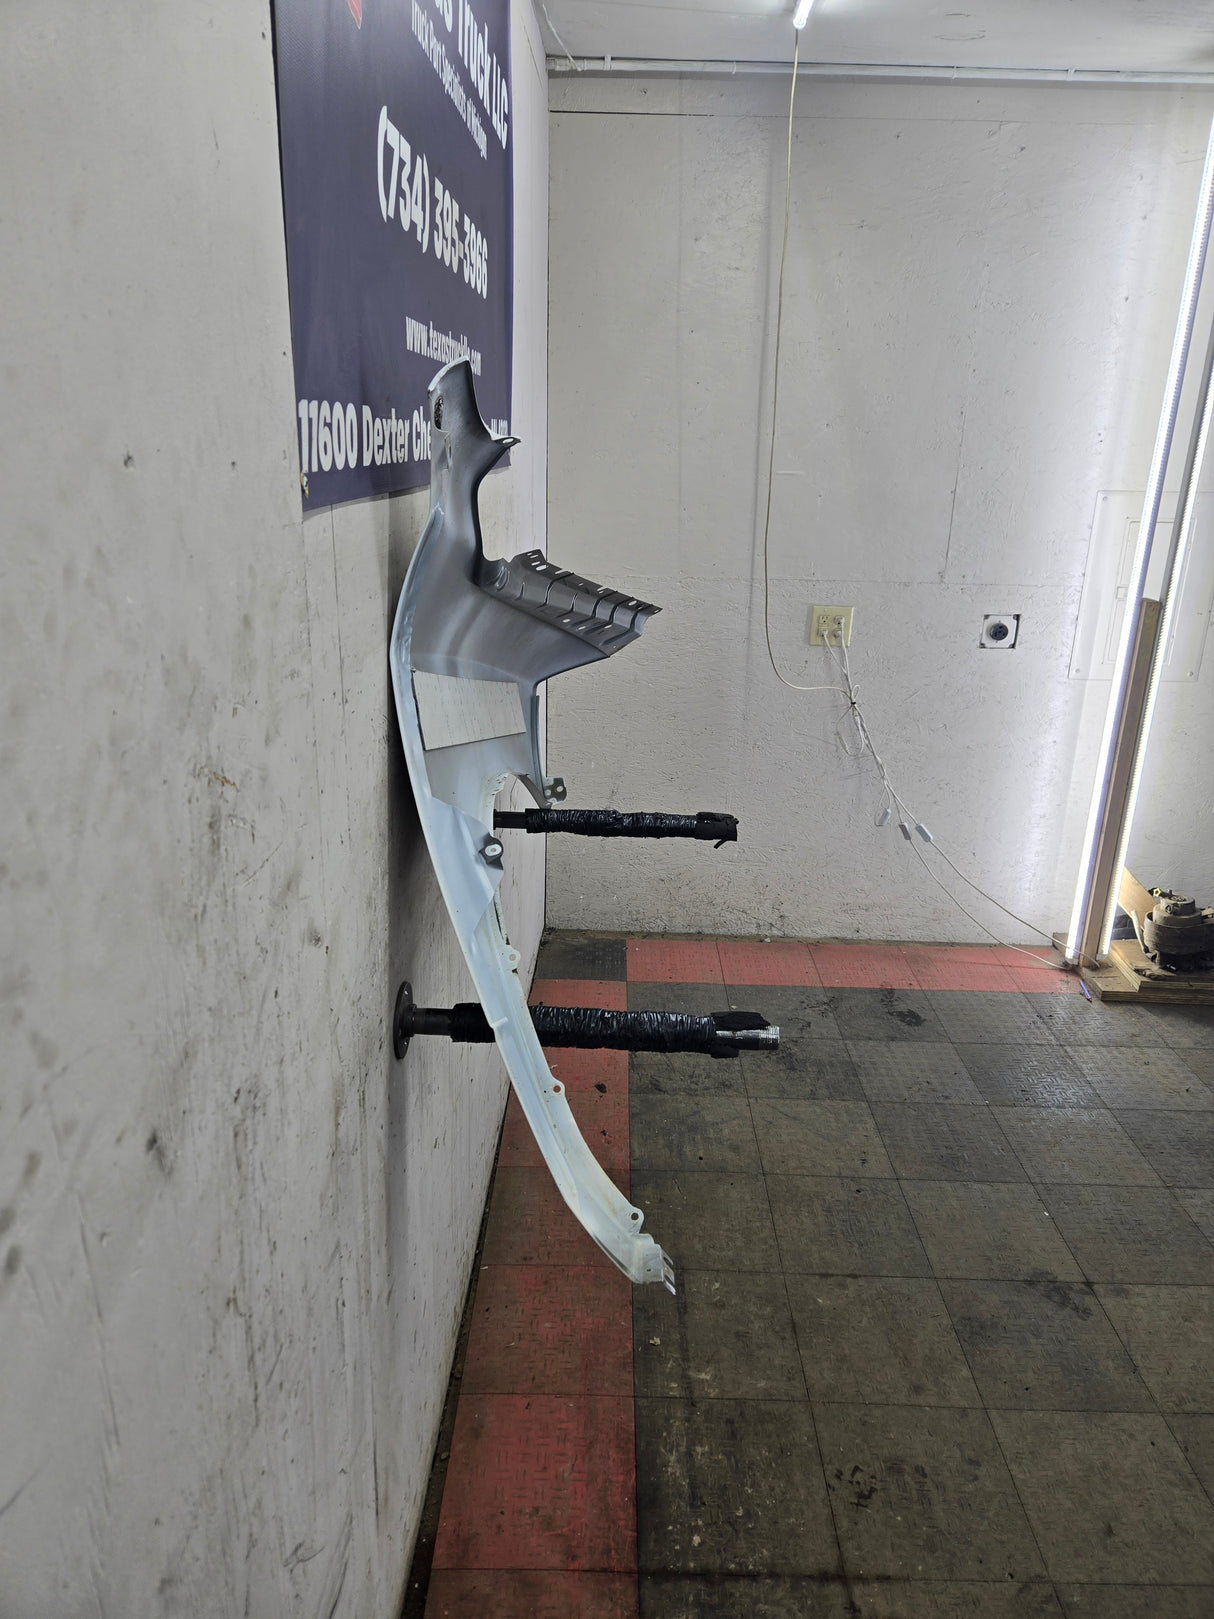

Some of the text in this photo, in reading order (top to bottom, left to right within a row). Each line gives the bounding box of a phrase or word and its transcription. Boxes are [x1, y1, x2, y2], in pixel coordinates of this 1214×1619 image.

[492, 52, 509, 150] LLC
[377, 105, 489, 300] (734) 395-3966
[298, 399, 432, 473] 11600 Dexter Che
